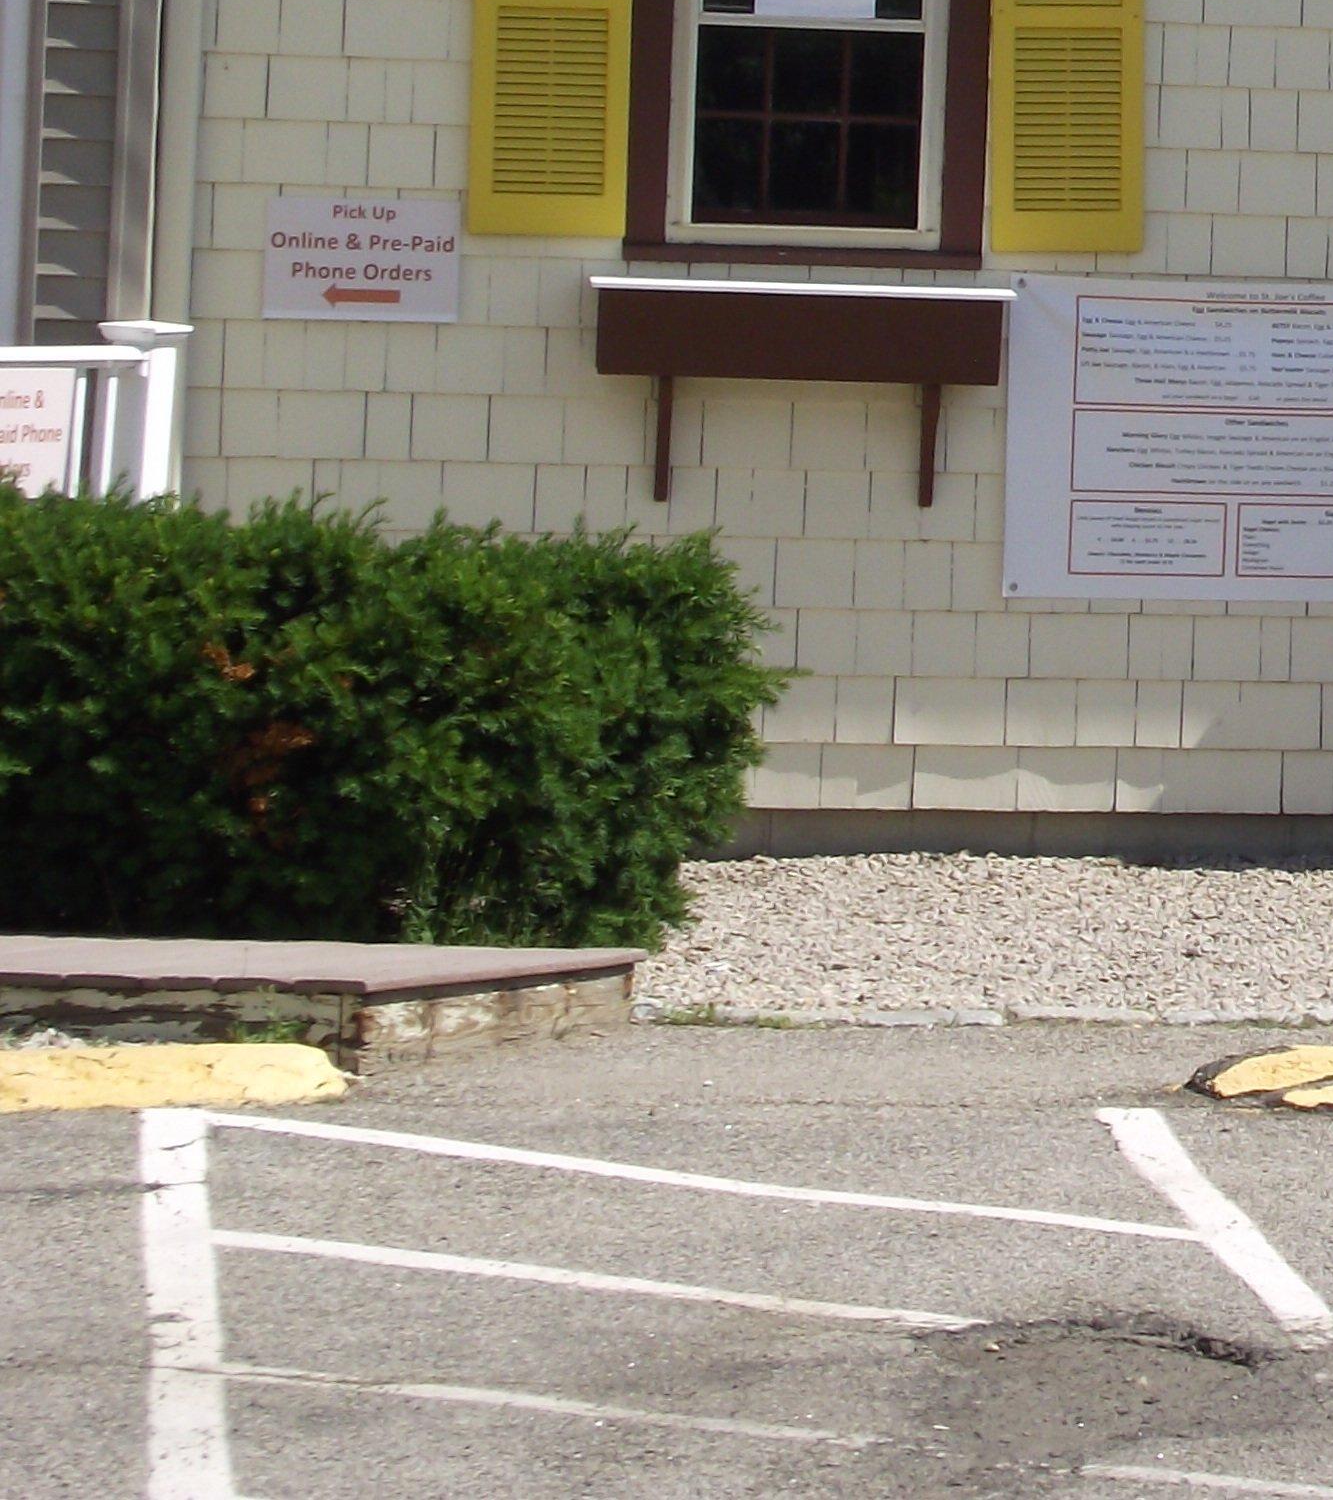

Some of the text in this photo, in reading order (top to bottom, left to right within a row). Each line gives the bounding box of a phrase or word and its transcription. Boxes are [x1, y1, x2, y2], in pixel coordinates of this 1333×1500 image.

[332, 204, 397, 223] Pick Up
[270, 230, 456, 254] Online & Pre-Paid
[291, 261, 433, 282] Phone Orders
[34, 389, 43, 409] &
[21, 423, 63, 443] Phone
